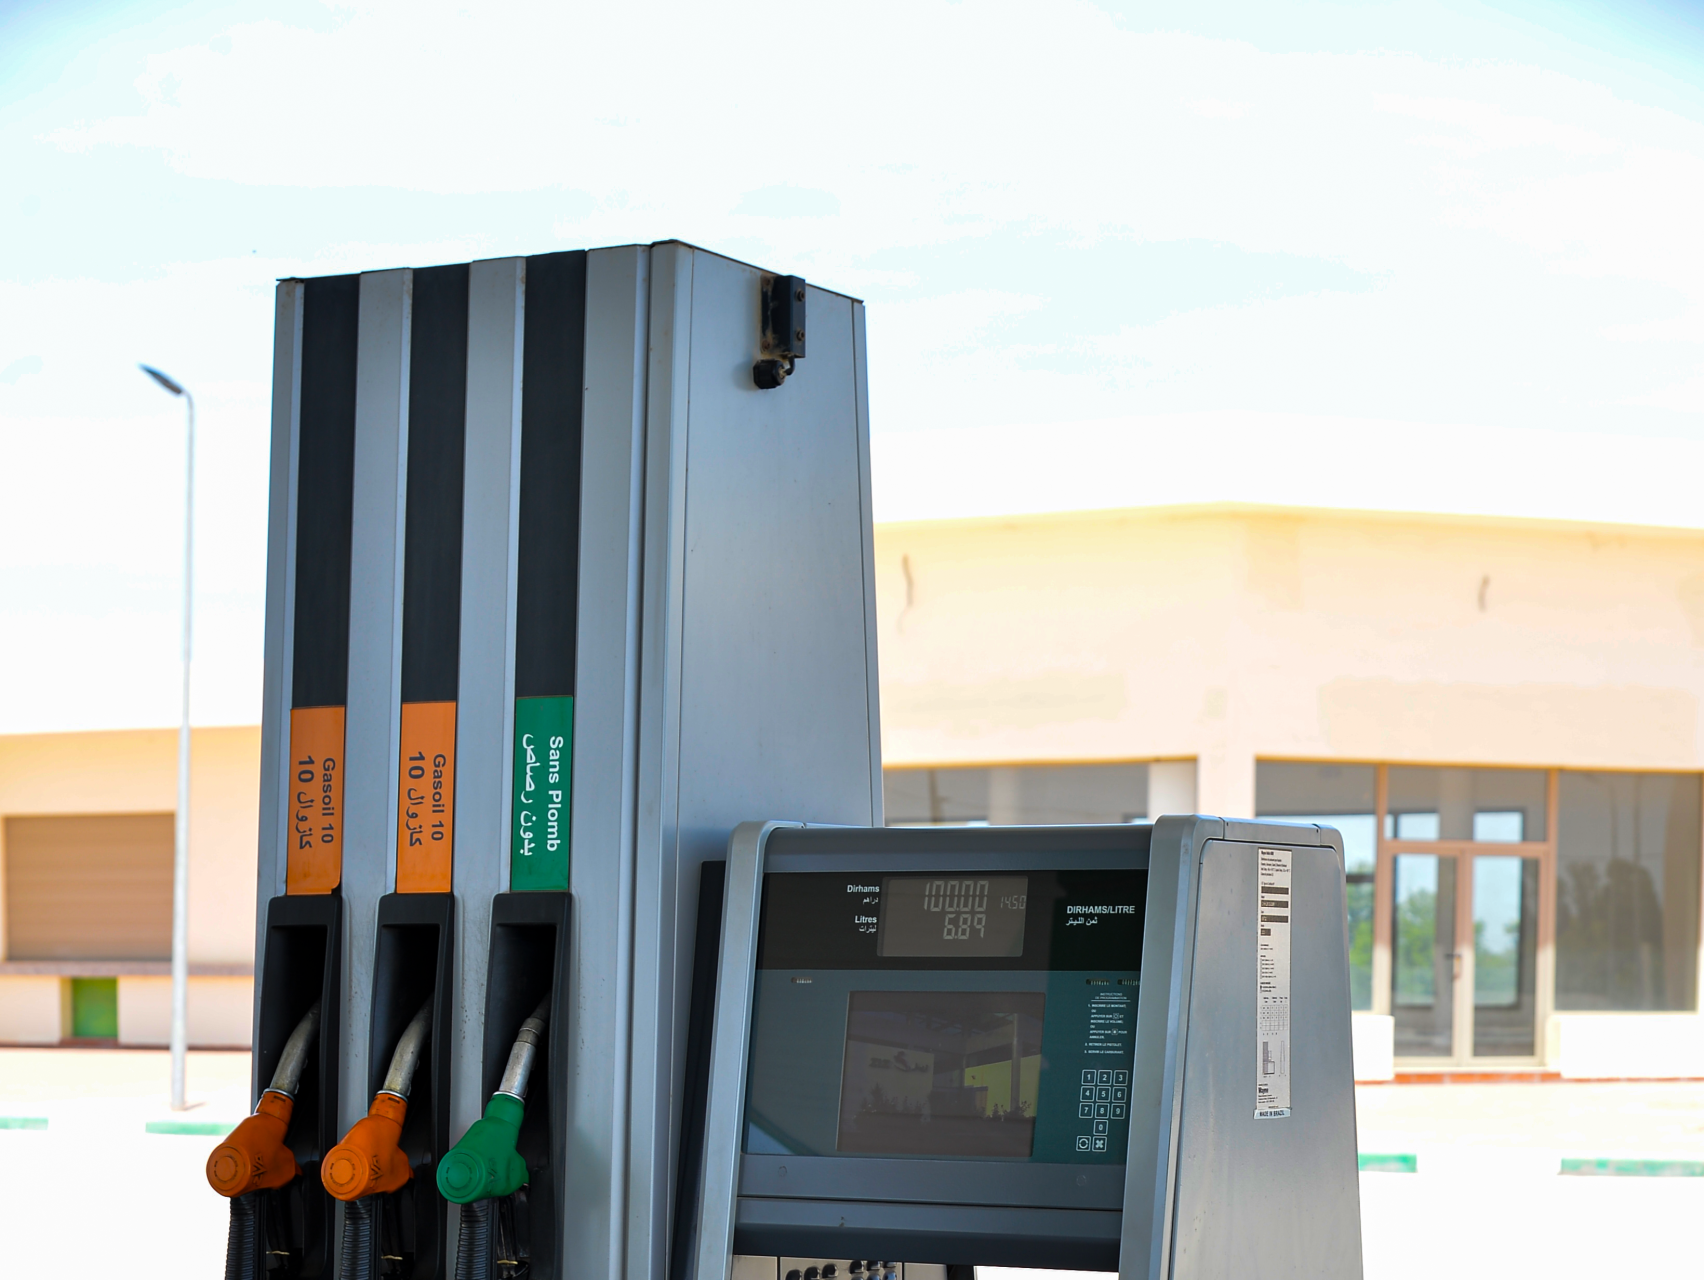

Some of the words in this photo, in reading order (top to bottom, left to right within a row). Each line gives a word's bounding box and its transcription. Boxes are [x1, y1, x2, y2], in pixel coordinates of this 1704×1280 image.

[298, 755, 315, 783] 10
[408, 751, 425, 780] 10
[520, 733, 540, 804] رصاص
[547, 735, 564, 784] Sans
[321, 757, 336, 817] Gasoil
[431, 753, 447, 814] Gasoil
[296, 791, 314, 850] كازوال
[406, 787, 425, 847] كازوال
[431, 820, 445, 841] 10
[546, 790, 563, 852] Plomb
[321, 823, 335, 844] 10
[519, 811, 538, 856] بدون
[847, 884, 880, 893] Dirhams
[862, 896, 879, 905] دراهم
[923, 880, 989, 912] 100.00
[854, 915, 877, 923] Litres
[1065, 916, 1085, 926] الليتر
[1066, 905, 1136, 914] DIRHAMS/LITRE
[1085, 916, 1098, 926] ثمن
[943, 913, 987, 940] 6.89
